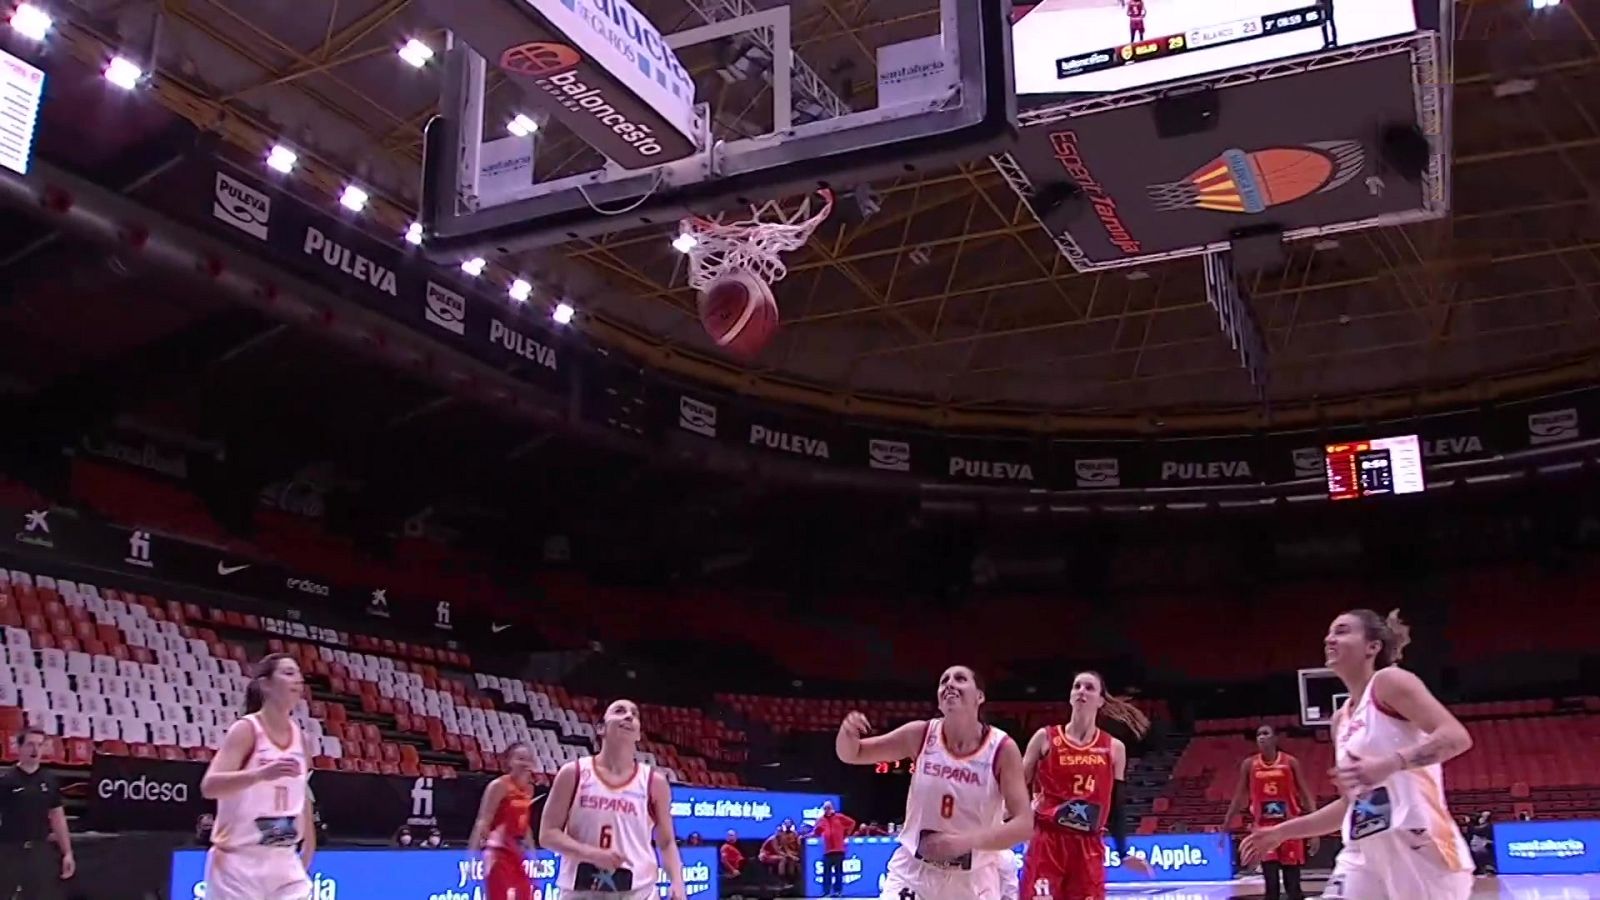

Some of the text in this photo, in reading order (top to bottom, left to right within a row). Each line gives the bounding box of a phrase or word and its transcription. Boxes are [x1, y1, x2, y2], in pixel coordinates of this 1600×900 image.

[219, 179, 267, 213] PULEVA
[303, 226, 398, 297] PULEVA
[489, 318, 558, 371] PULEVA
[750, 424, 830, 458] PULEVA
[1423, 436, 1483, 457] LEVA
[949, 456, 1034, 481] PULEVA
[1161, 461, 1252, 480] PULEVA
[1059, 754, 1107, 767] ESPAÑA
[923, 762, 981, 787] ESPAÑA
[1073, 774, 1096, 795] 24
[98, 775, 188, 802] endesa
[580, 795, 638, 817] ESPAÑA
[940, 795, 955, 819] 8
[600, 825, 613, 850] 6
[1151, 844, 1209, 871] Apple.
